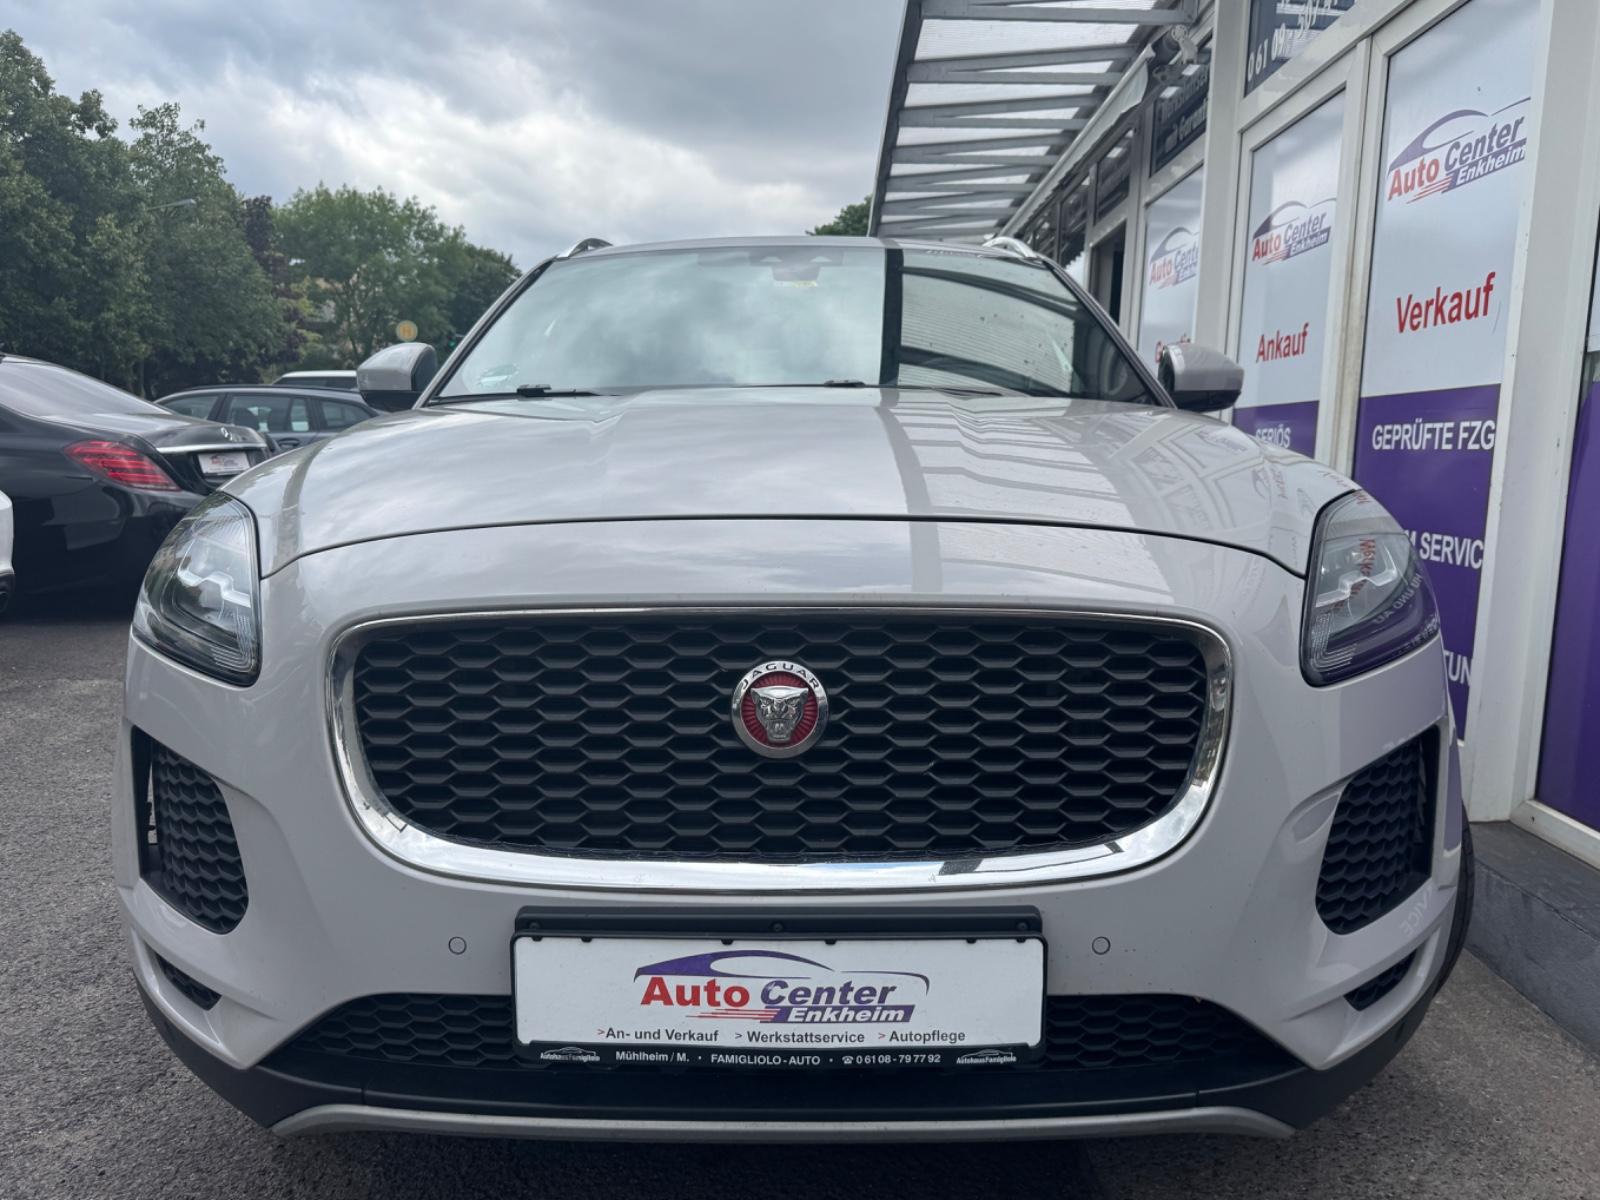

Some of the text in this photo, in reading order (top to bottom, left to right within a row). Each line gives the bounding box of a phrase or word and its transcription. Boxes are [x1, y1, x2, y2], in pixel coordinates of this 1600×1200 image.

[1388, 116, 1525, 201] Auto Center
[1456, 147, 1526, 186] Enkheim
[1252, 211, 1327, 262] Auto Center
[1396, 272, 1496, 334] Verkauf
[1256, 322, 1309, 363] Ankauf
[1372, 417, 1496, 450] GEPRÜFTE FZG
[1420, 531, 1484, 569] SERVIC
[742, 662, 820, 690] JAGUAR
[640, 976, 897, 1007] Auto Center
[787, 1006, 905, 1023] Enkheim
[634, 1029, 661, 1041] und
[665, 1030, 719, 1042] Verkauf
[747, 1031, 865, 1044] Werkstattservice
[889, 1030, 966, 1044] Autopflege
[615, 1051, 669, 1062] Mühlheim
